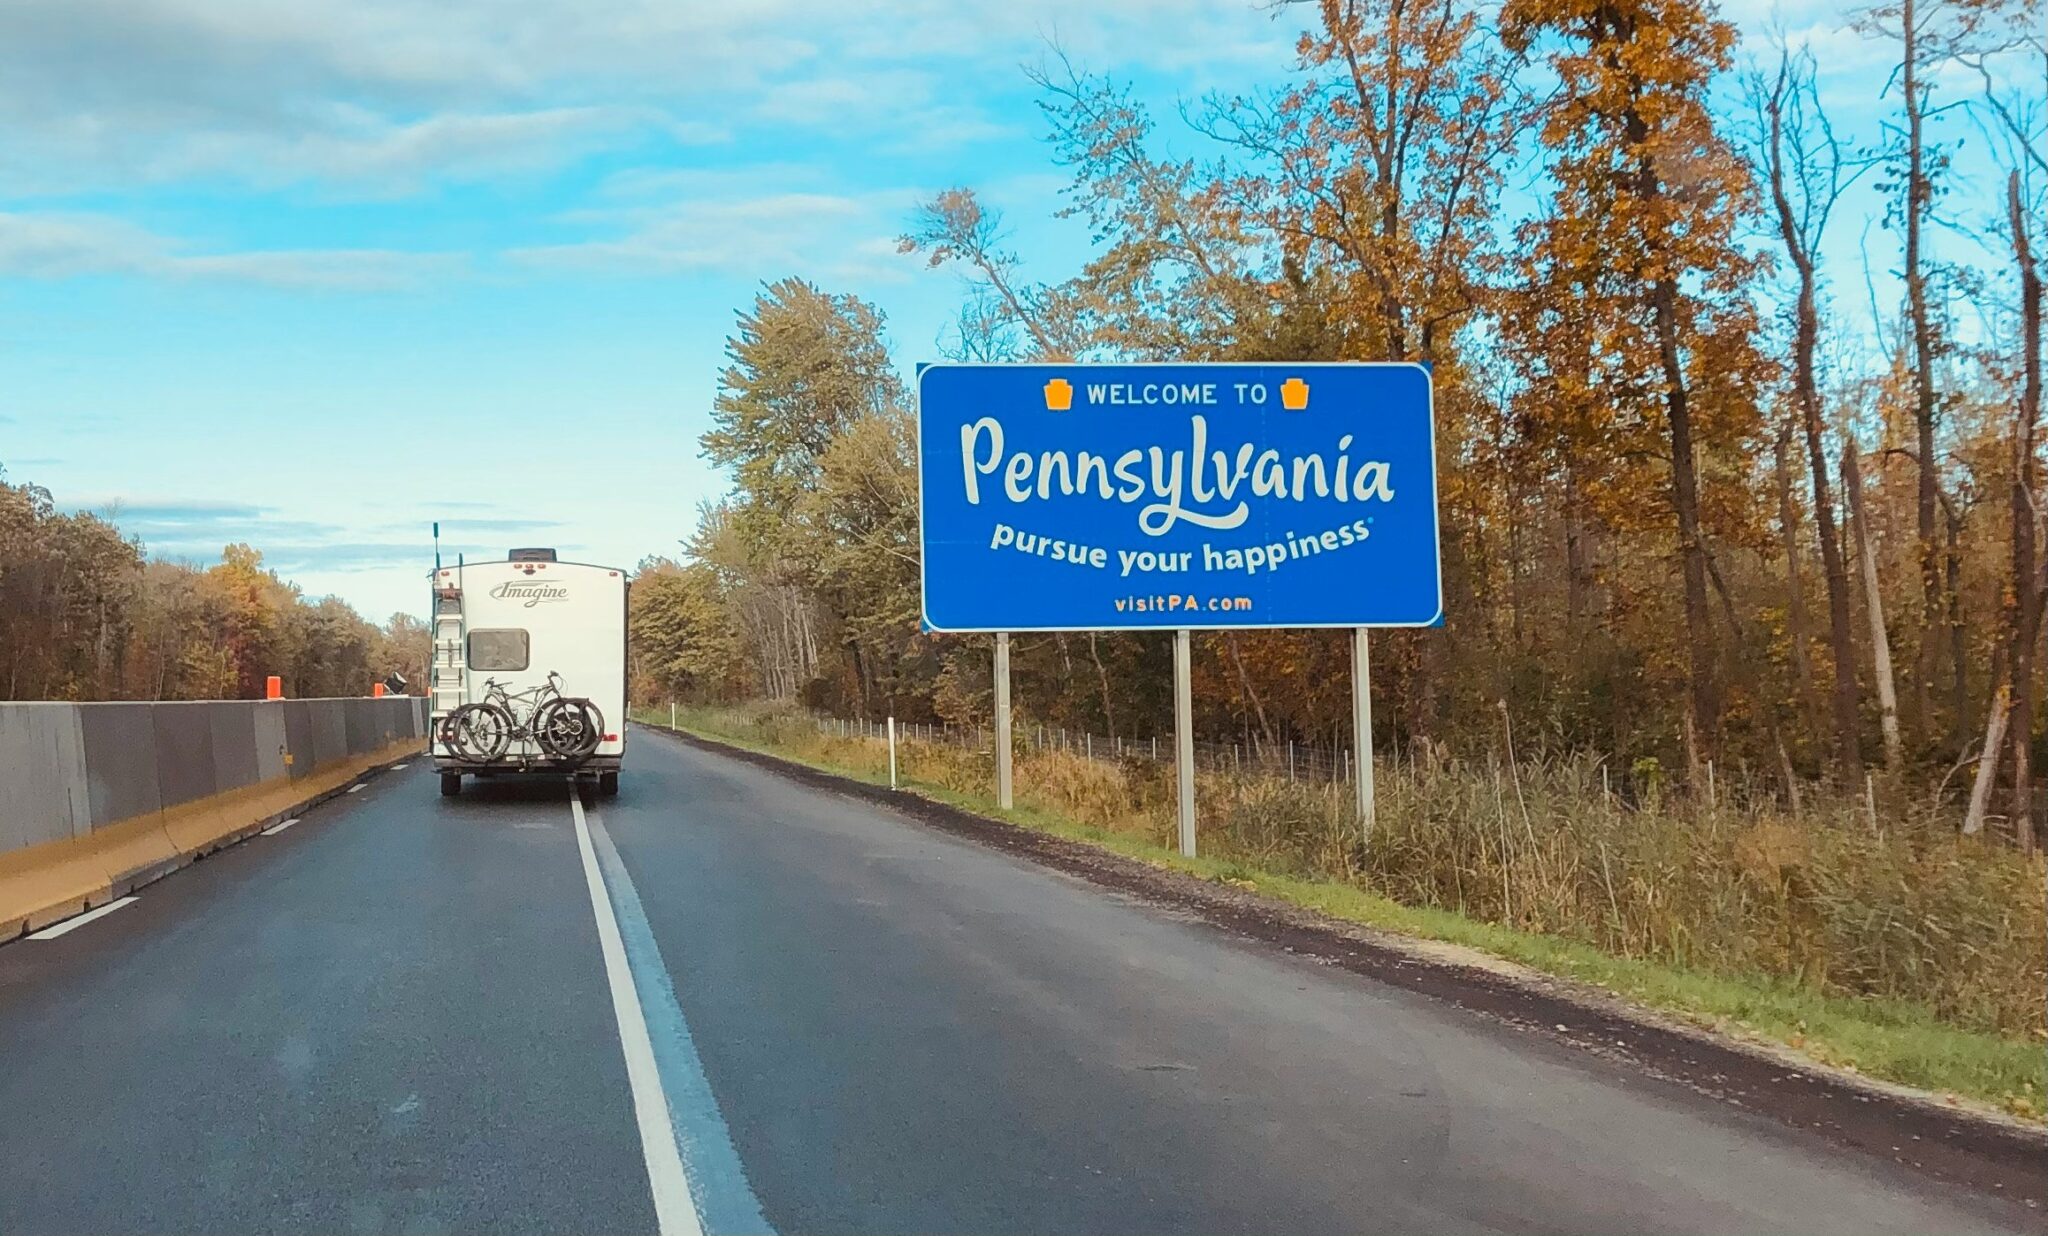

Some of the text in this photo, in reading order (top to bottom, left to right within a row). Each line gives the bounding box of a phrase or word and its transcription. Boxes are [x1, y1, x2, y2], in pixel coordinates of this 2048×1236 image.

[1087, 384, 1267, 405] WELCOME TO
[960, 415, 1395, 536] Pennsylvania
[990, 519, 1370, 577] pursue your happiness
[498, 580, 568, 608] Imagine
[1114, 594, 1252, 612] visitPA.com
